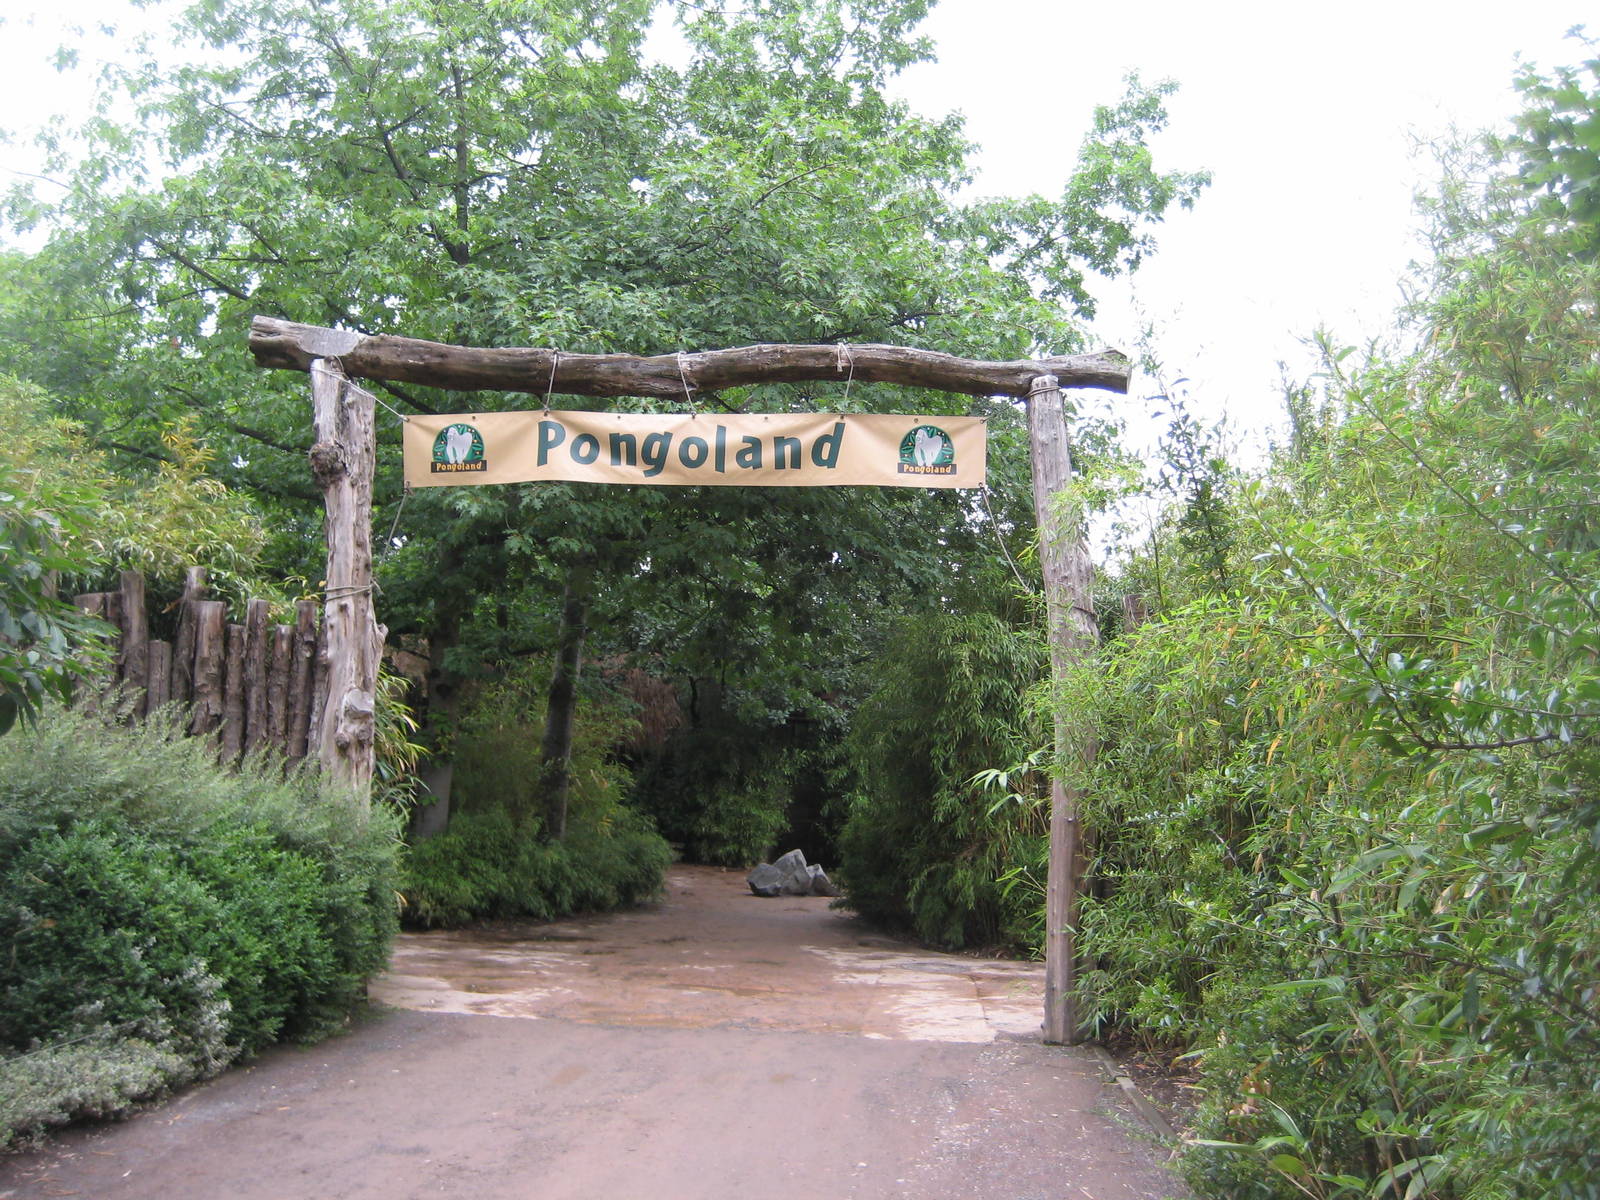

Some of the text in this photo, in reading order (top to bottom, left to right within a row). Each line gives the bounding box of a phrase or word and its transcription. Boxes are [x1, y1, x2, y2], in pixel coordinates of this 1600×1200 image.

[537, 420, 846, 478] Pongoland
[436, 461, 482, 472] Pongoland
[903, 464, 952, 474] Pongoland
